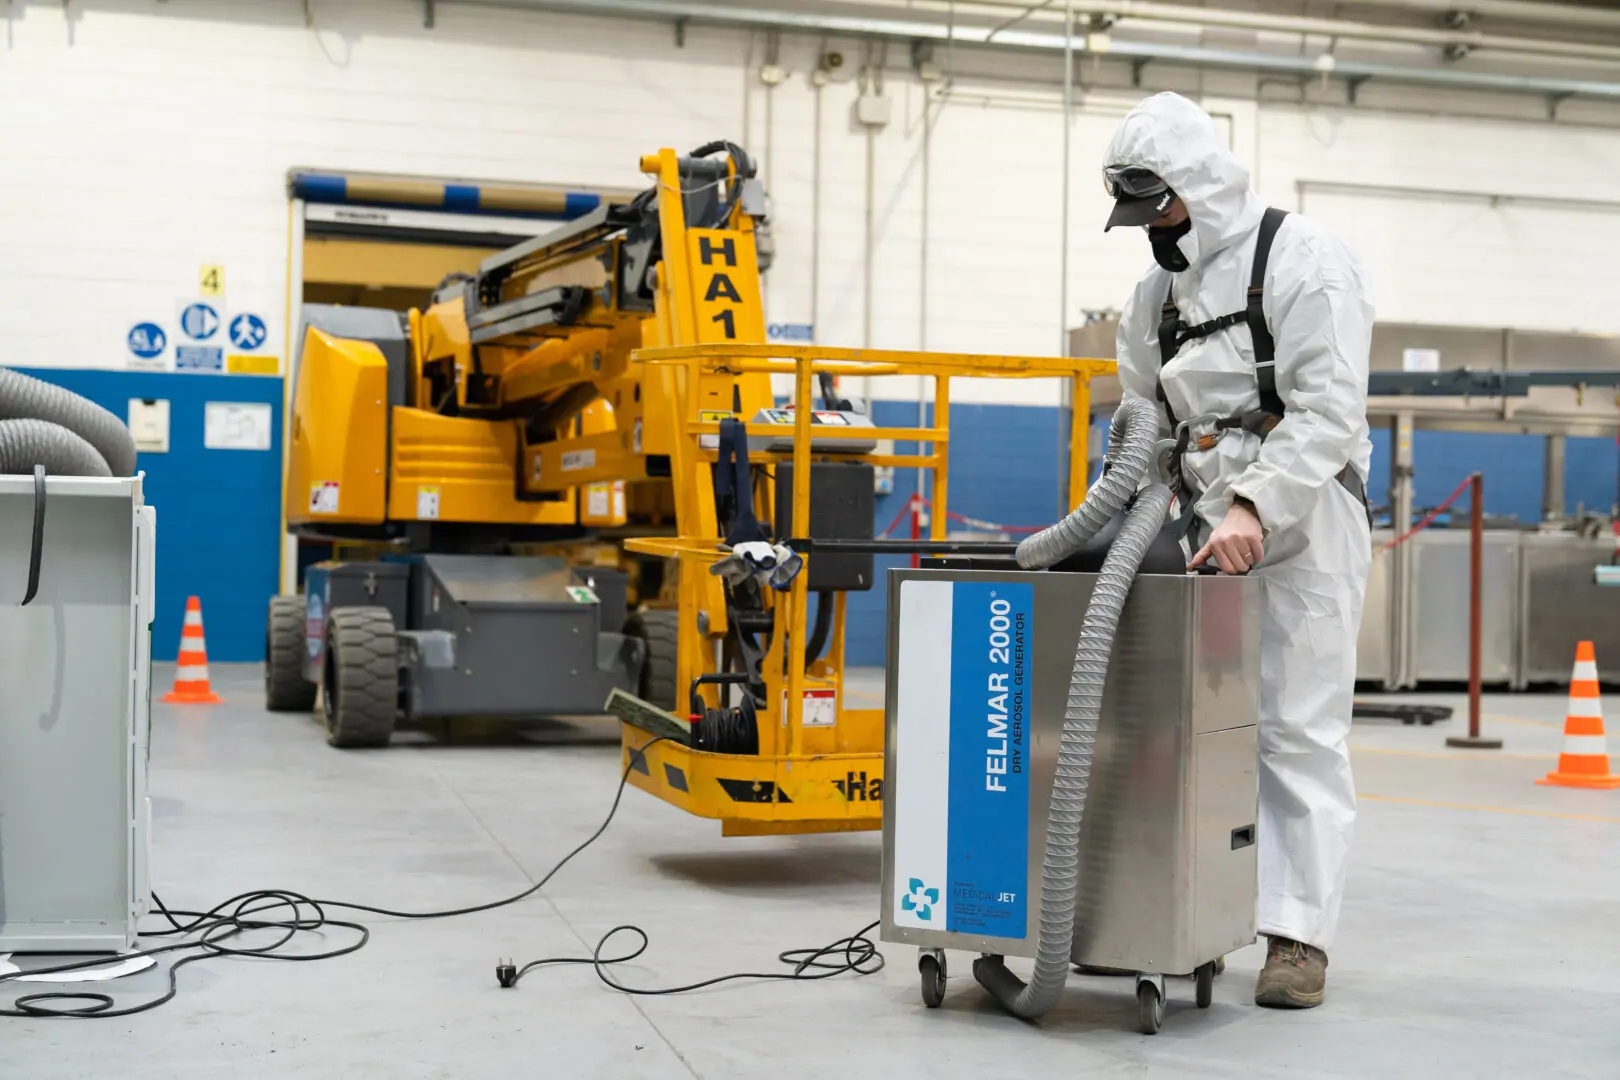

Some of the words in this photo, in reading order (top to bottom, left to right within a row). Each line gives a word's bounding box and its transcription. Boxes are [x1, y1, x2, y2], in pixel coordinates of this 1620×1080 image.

[201, 269, 220, 292] 4
[1014, 613, 1025, 686] GENERATOR
[986, 673, 1009, 792] FELMAR
[1013, 689, 1023, 746] AEROSOL
[1012, 749, 1022, 774] DRY
